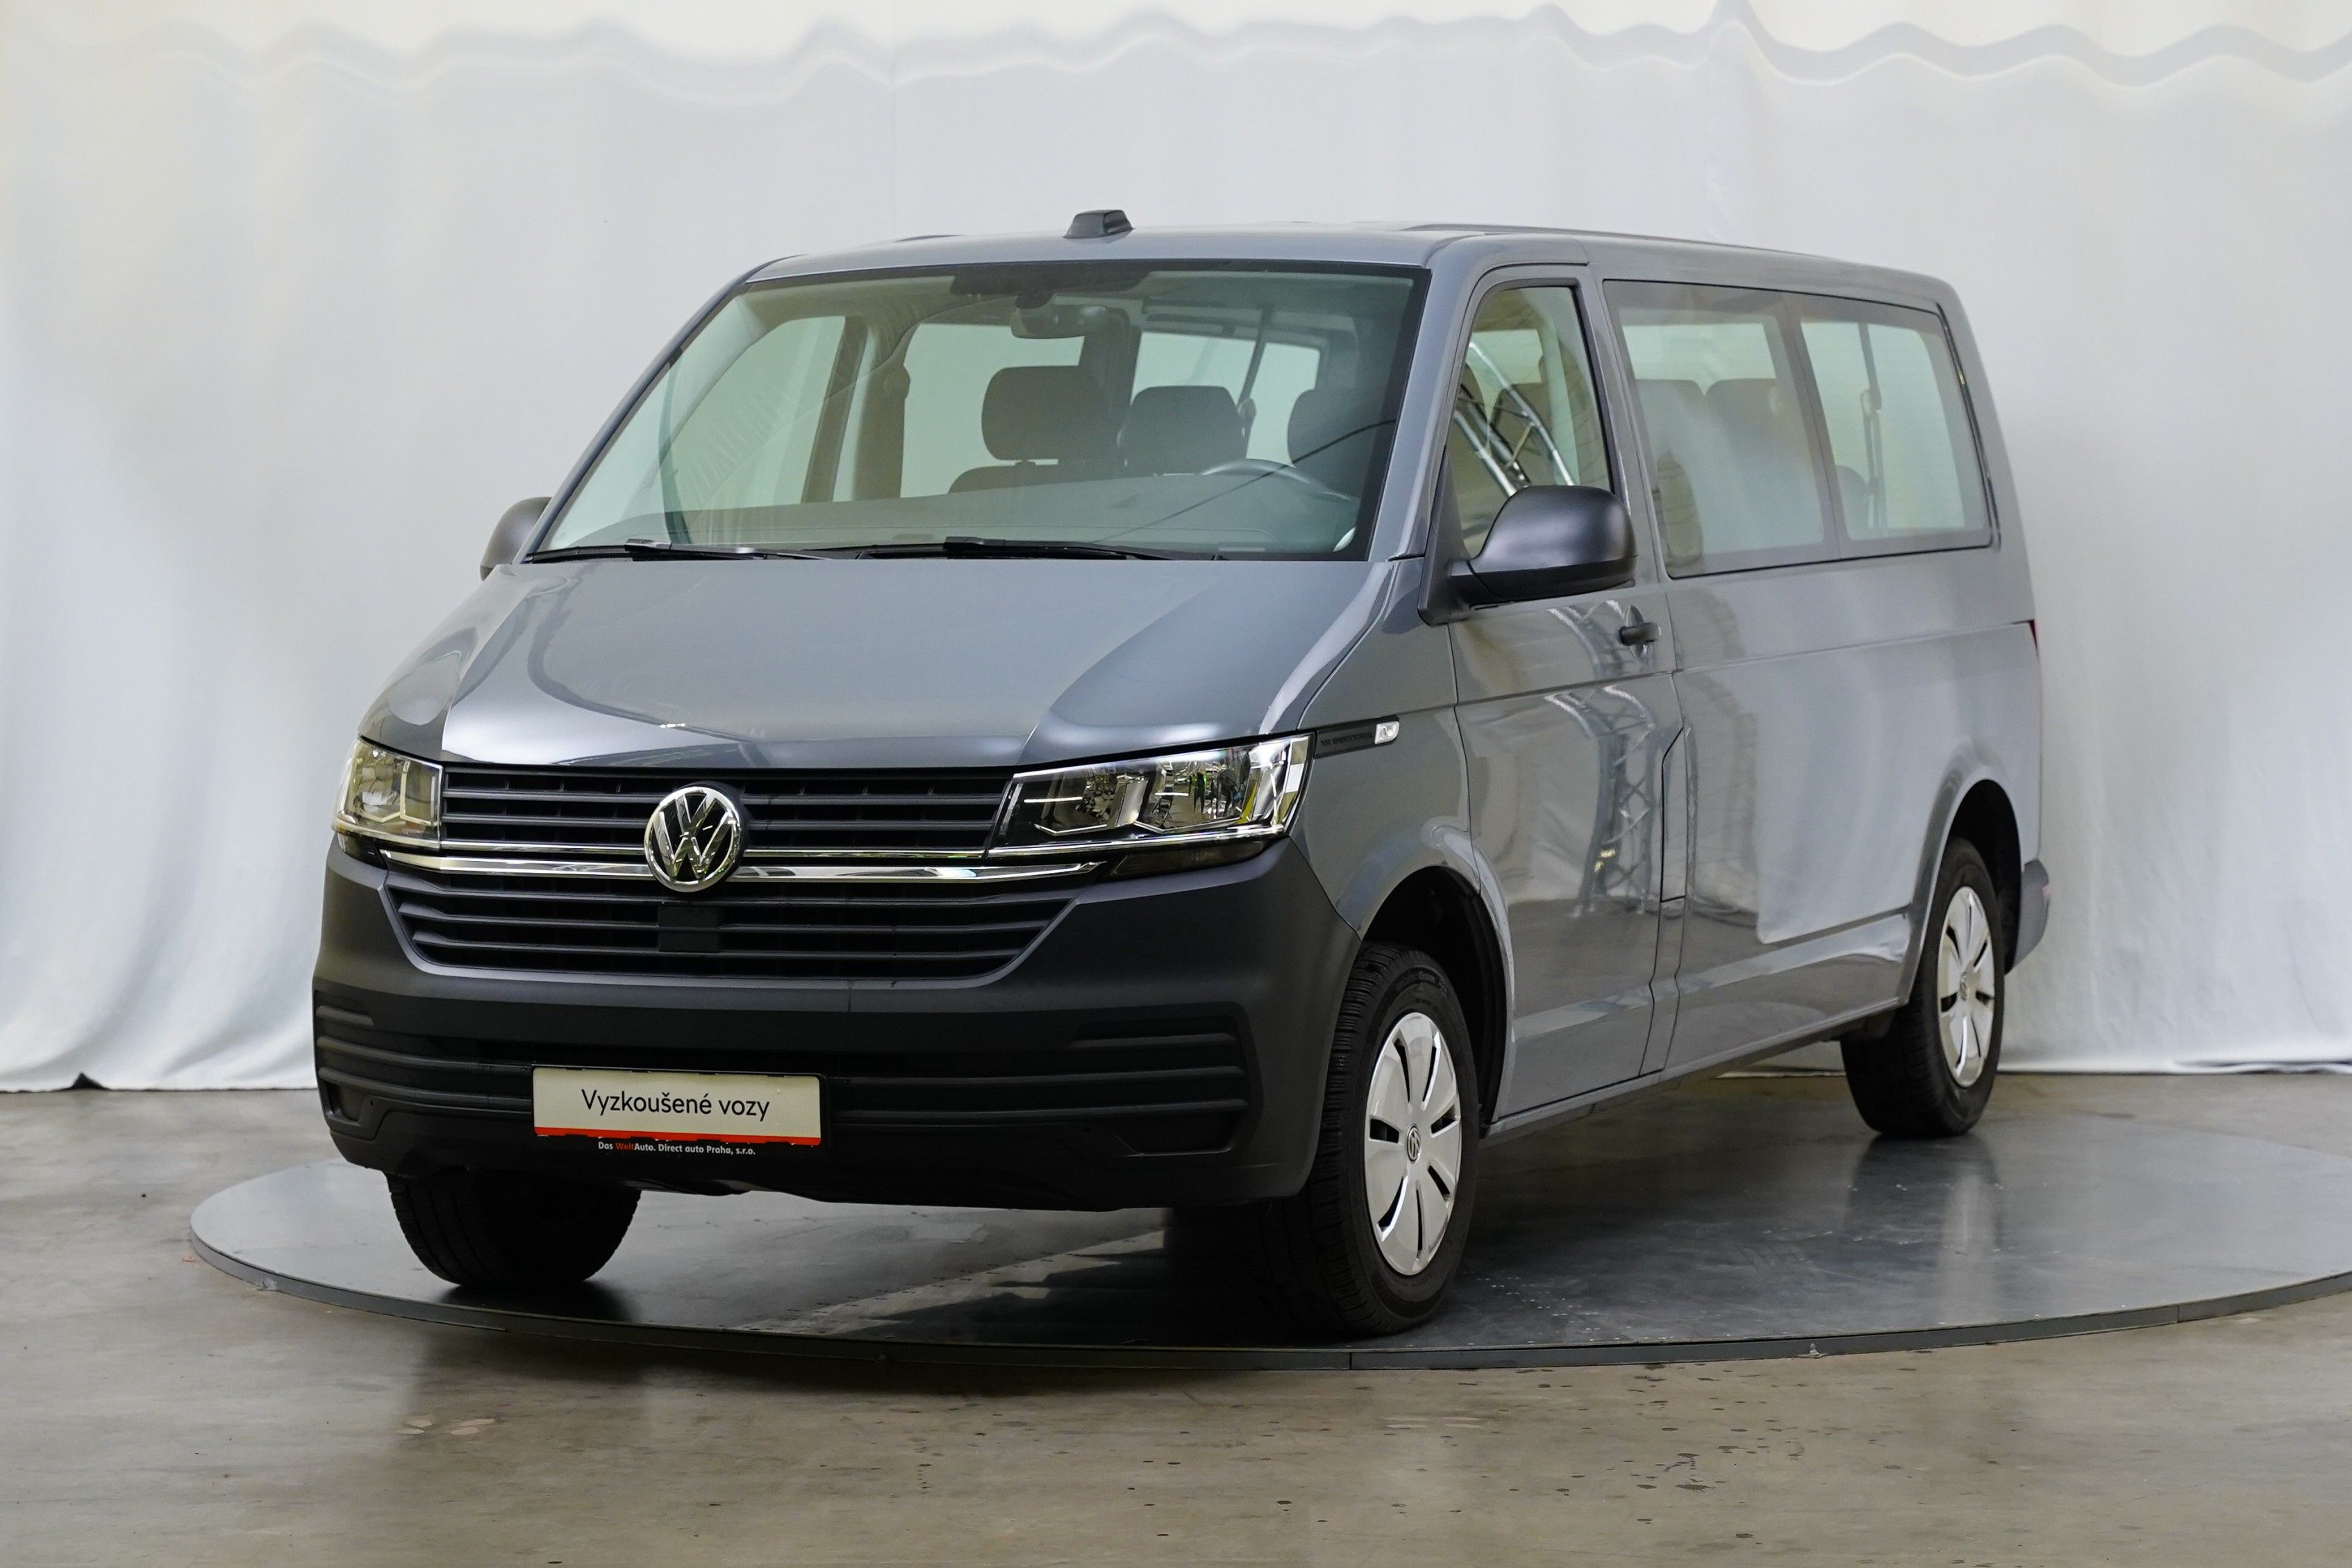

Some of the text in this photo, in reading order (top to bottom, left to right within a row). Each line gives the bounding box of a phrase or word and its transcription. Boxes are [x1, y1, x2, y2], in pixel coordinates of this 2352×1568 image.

[645, 787, 740, 892] VW
[581, 1088, 770, 1121] Vyzkoušené vozy
[598, 1141, 613, 1150] Das
[615, 1142, 656, 1151] WeltAuto.
[658, 1143, 683, 1153] Direct
[685, 1145, 704, 1153] auto
[706, 1145, 733, 1156] Praha,
